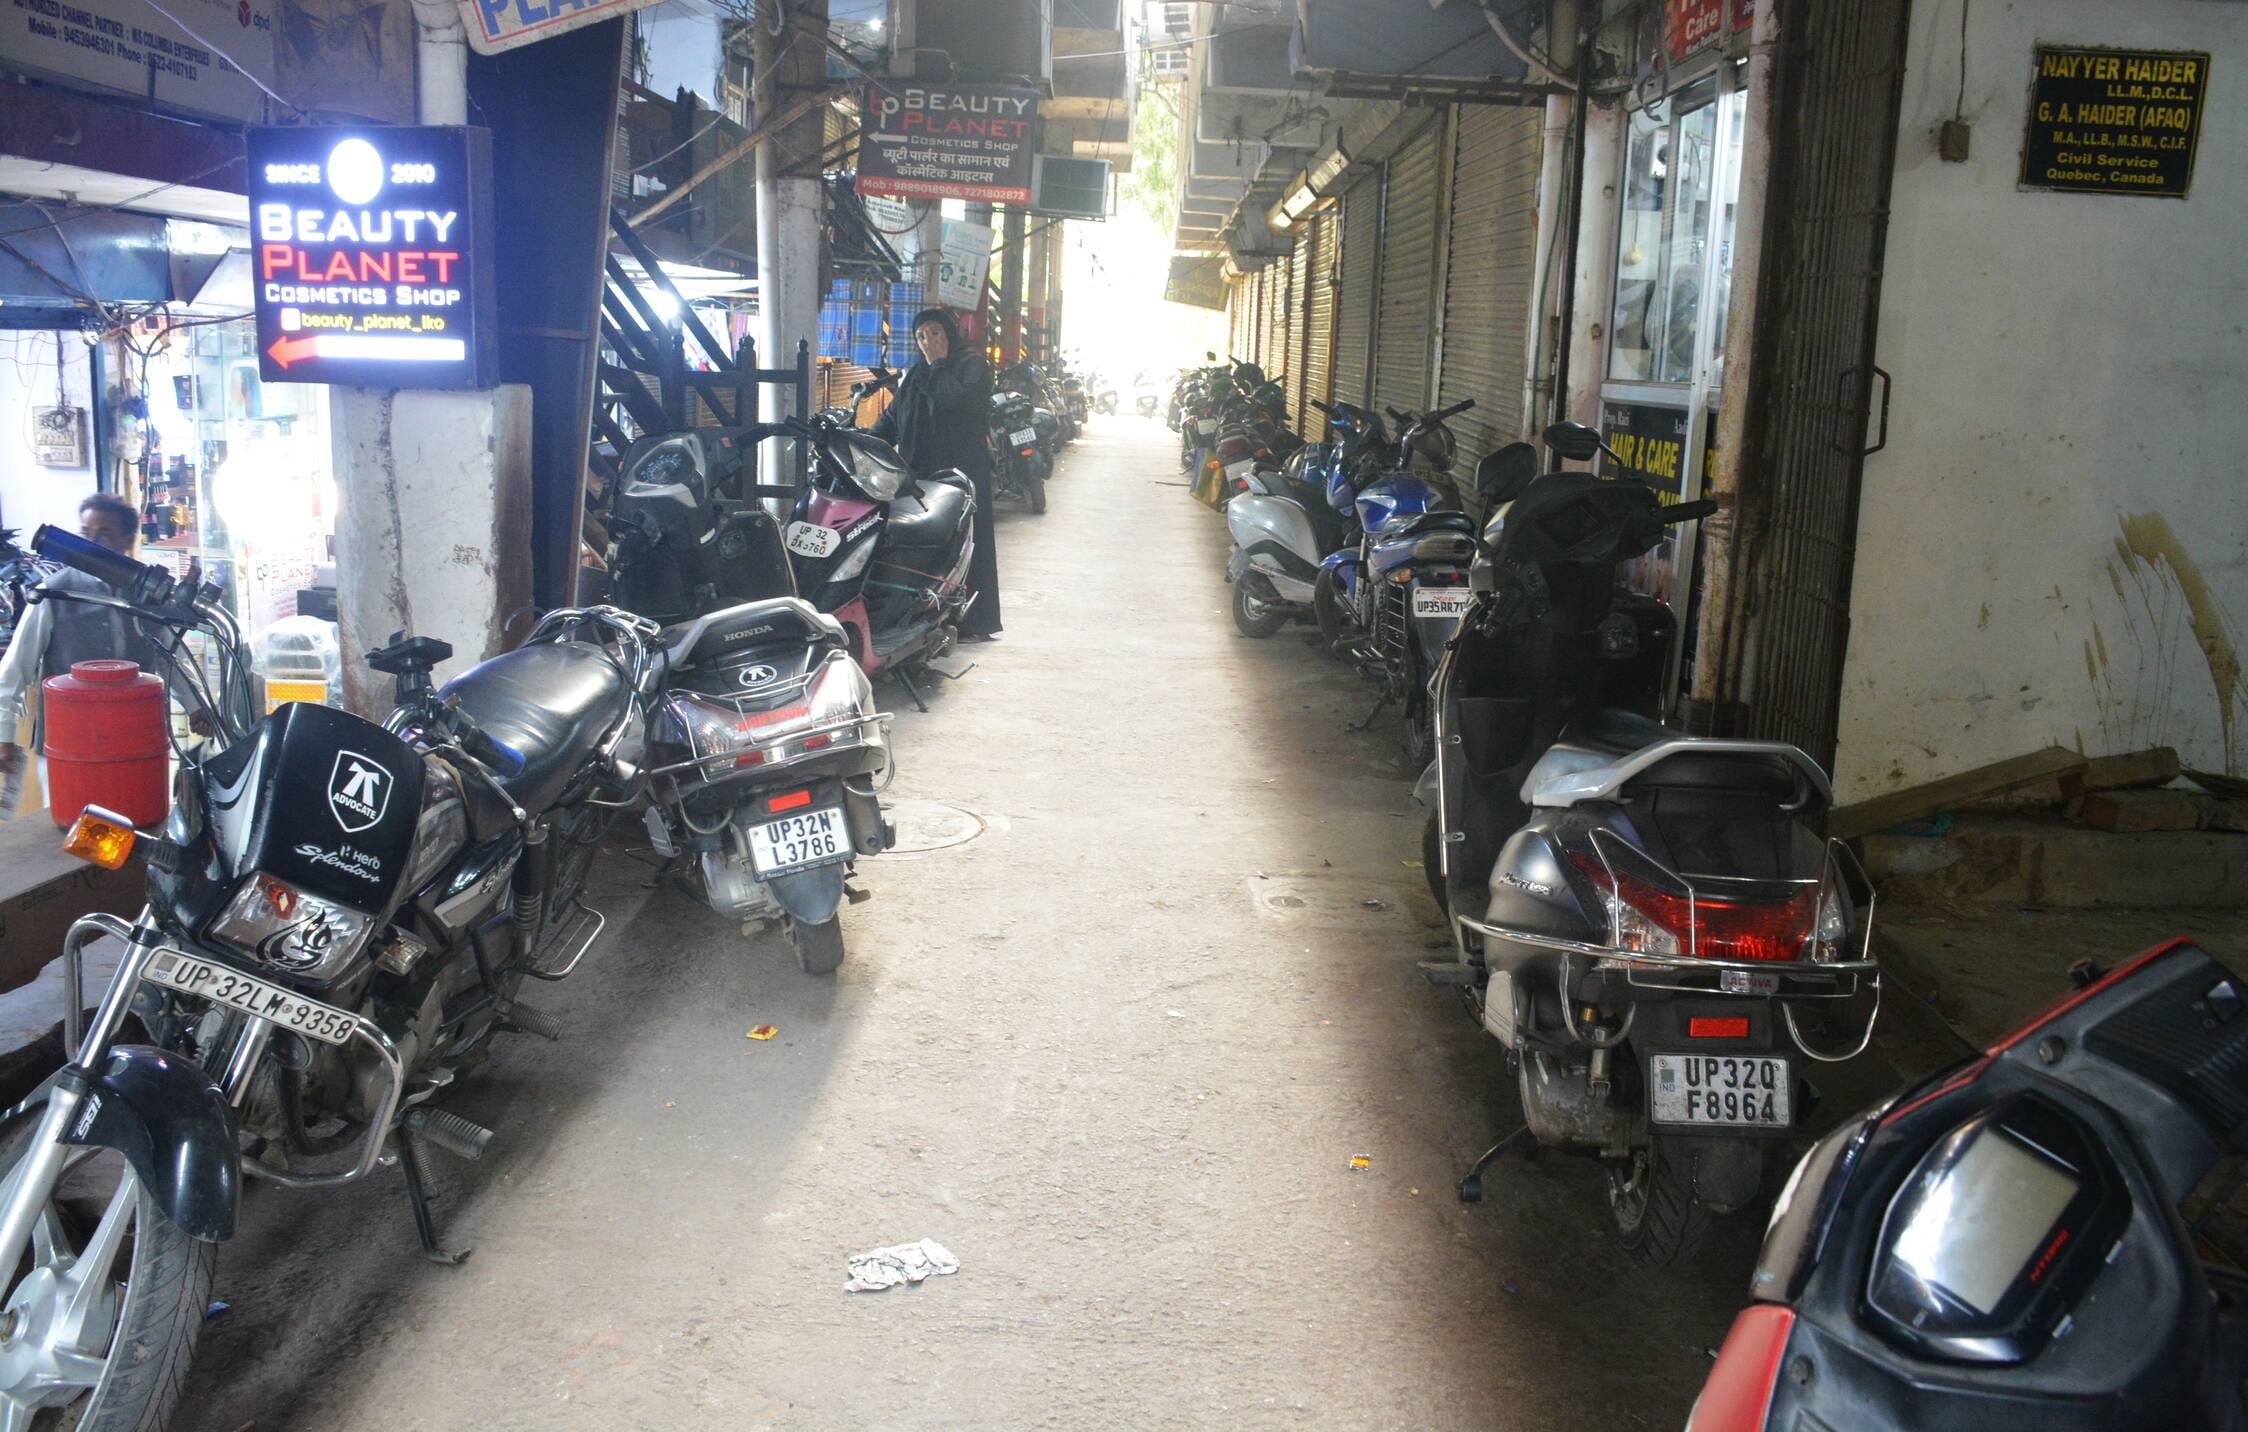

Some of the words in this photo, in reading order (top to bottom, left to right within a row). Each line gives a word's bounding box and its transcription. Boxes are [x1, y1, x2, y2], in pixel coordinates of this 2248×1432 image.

[1685, 8, 1719, 40] Care
[2043, 56, 2120, 81] NAYYER
[2124, 59, 2197, 83] HAIDER
[905, 89, 1030, 115] BEAUTY
[903, 111, 1029, 139] PLANET
[2038, 102, 2053, 122] G.
[2057, 103, 2073, 123] A.
[2077, 103, 2136, 126] HAIDER
[2140, 105, 2191, 132] (AFAQ)
[910, 135, 979, 149] COSMETICS
[984, 140, 1019, 151] SHOP
[883, 147, 907, 163] ब्यूटी
[940, 153, 955, 164] का
[957, 155, 991, 167] सामान
[993, 155, 1010, 168] एवं
[2057, 152, 2092, 165] Civil
[2096, 154, 2159, 168] Service
[391, 163, 436, 184] 2010
[2110, 171, 2164, 185] Canada
[259, 204, 457, 242] BEAUTY
[262, 245, 459, 282] PLANET
[265, 283, 387, 304] COSMETICS
[395, 285, 460, 306] SHOP
[1608, 431, 1636, 468] HAIR
[1635, 436, 1645, 471] &
[1646, 438, 1680, 478] CARE
[799, 525, 812, 536] UP
[815, 529, 828, 540] 32
[724, 624, 774, 642] HONDA
[333, 792, 377, 820] ADVOCATE
[766, 812, 831, 844] UP32N
[772, 834, 836, 866] L3786
[153, 969, 169, 980] IND
[290, 1005, 353, 1040] 9358
[1685, 1057, 1775, 1089] UP32Q
[1687, 1090, 1775, 1122] F8964
